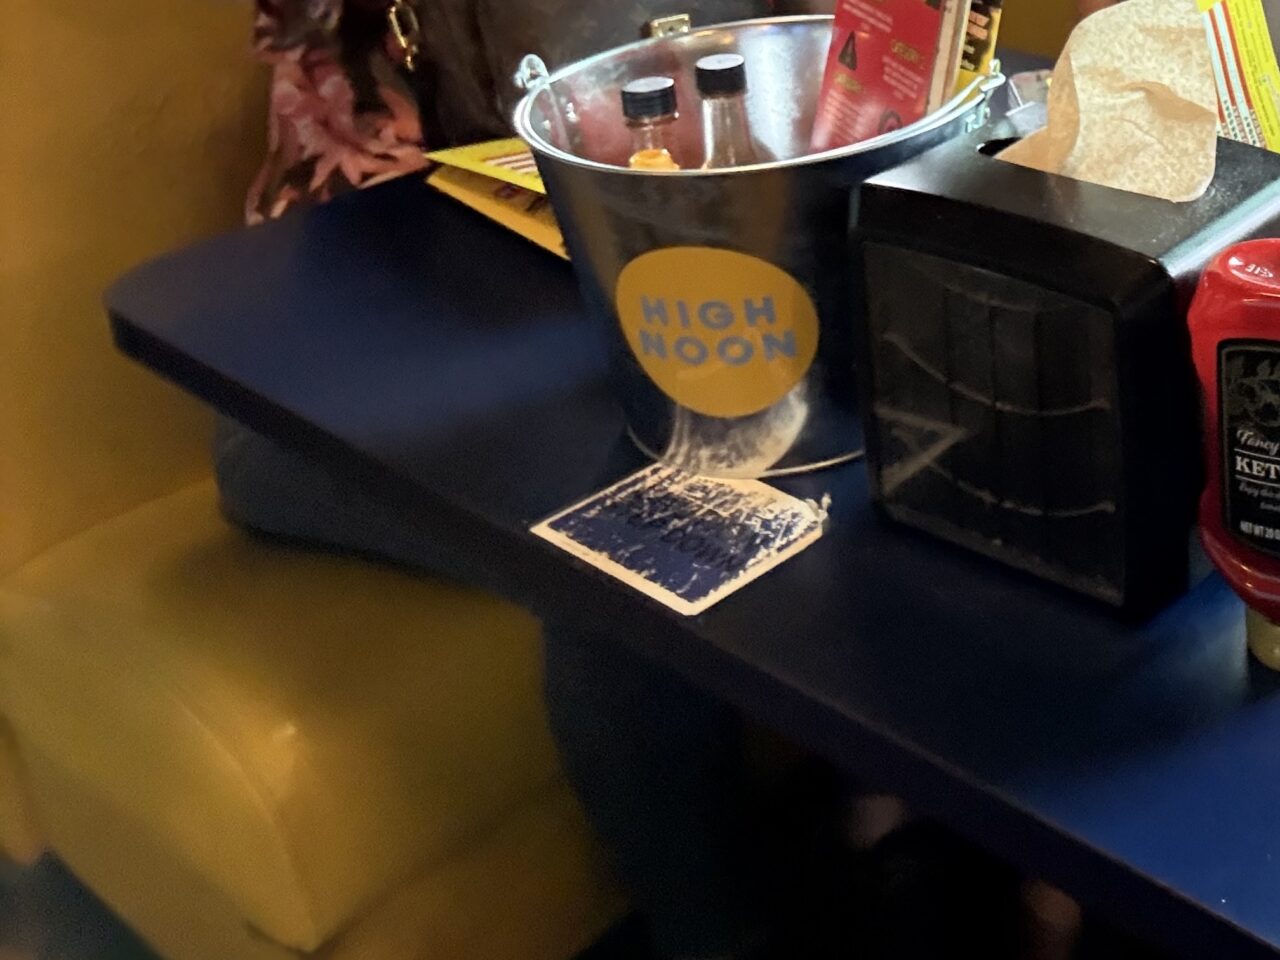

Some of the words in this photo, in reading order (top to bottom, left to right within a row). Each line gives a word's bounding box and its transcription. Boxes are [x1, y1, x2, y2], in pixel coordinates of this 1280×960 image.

[639, 294, 777, 331] HIGH
[638, 328, 797, 368] NOON
[1236, 429, 1280, 455] Fancy
[1240, 520, 1253, 534] NET
